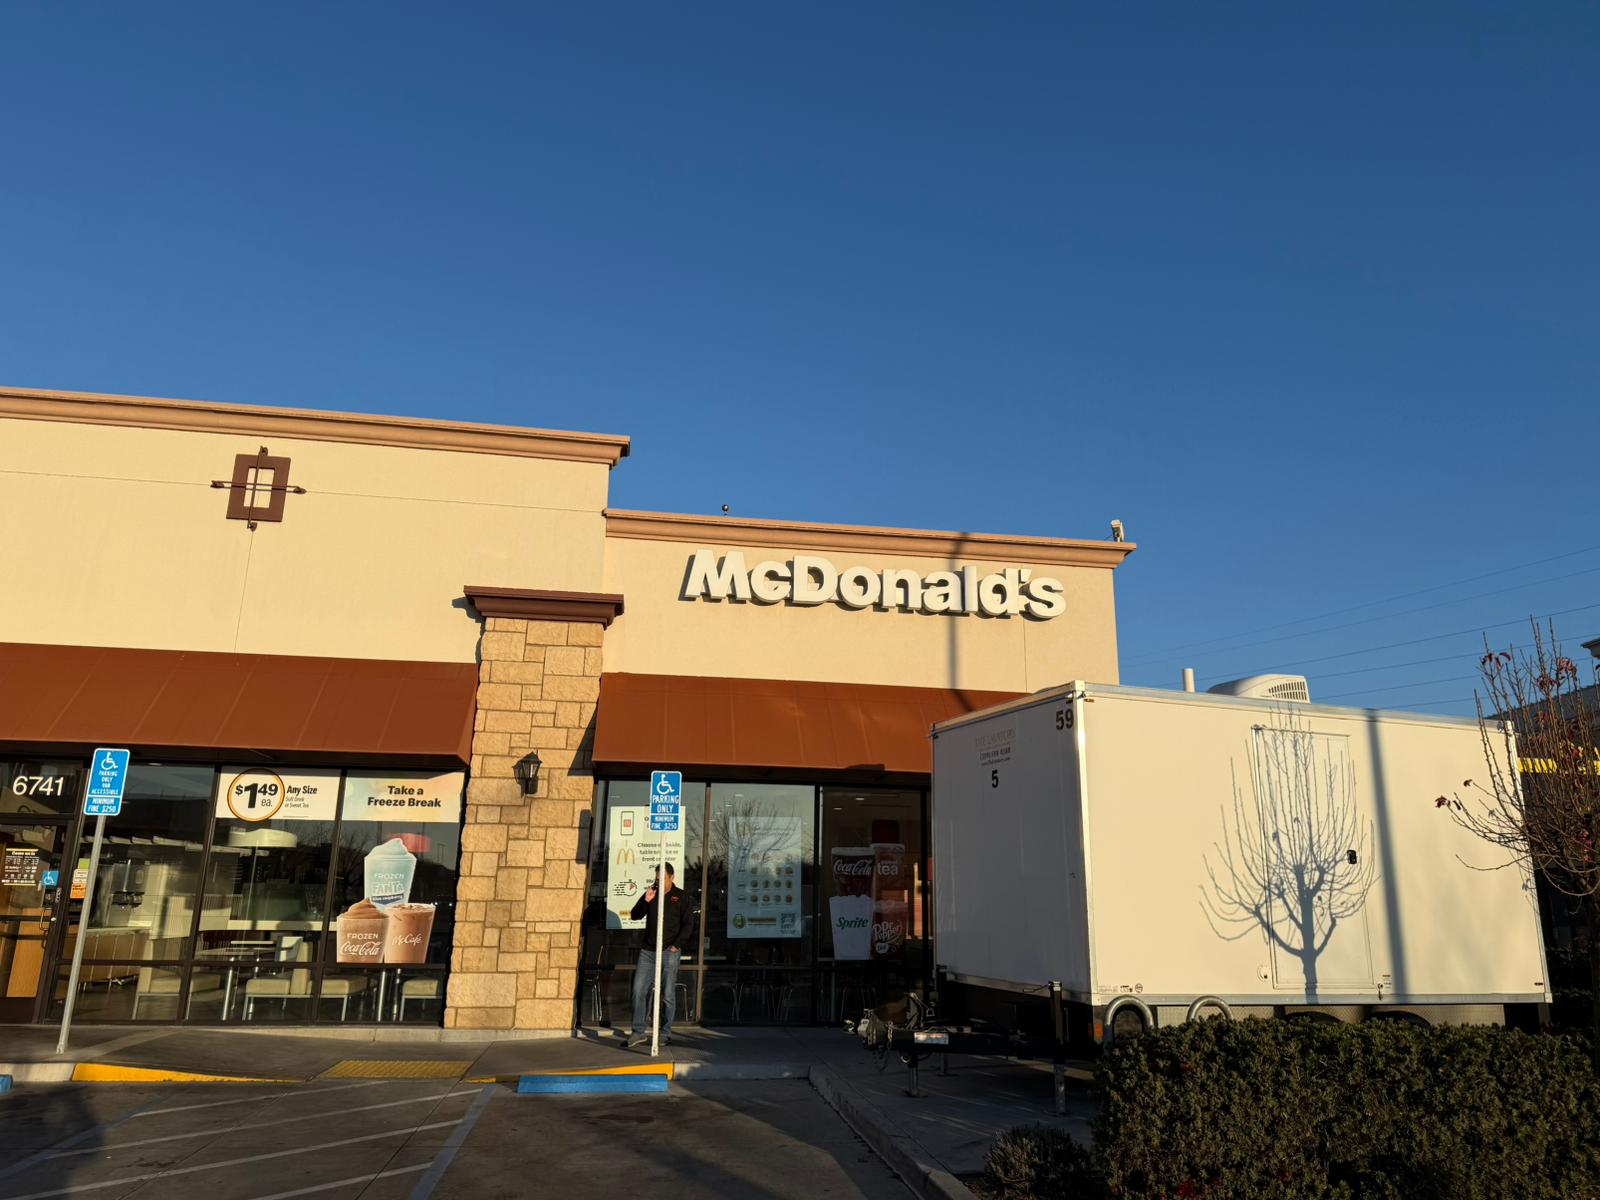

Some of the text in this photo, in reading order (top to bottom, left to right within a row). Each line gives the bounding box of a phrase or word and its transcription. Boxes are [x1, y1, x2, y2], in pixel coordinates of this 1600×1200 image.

[684, 548, 1067, 619] McDonald's
[1055, 708, 1074, 730] 59
[991, 769, 999, 788] 5
[12, 775, 64, 797] 6741
[286, 785, 318, 796] Any Size
[387, 785, 424, 796] Take a
[92, 797, 115, 805] MINIMUM
[260, 798, 273, 807] ea.
[367, 796, 442, 808] Freeze Break
[652, 795, 679, 804] PARKING
[87, 804, 117, 813] FINE $250
[656, 804, 674, 813] ONLY
[877, 861, 899, 876] tea
[372, 882, 404, 894] FANTA
[835, 917, 869, 930] Sprite
[391, 933, 424, 946] McCafé
